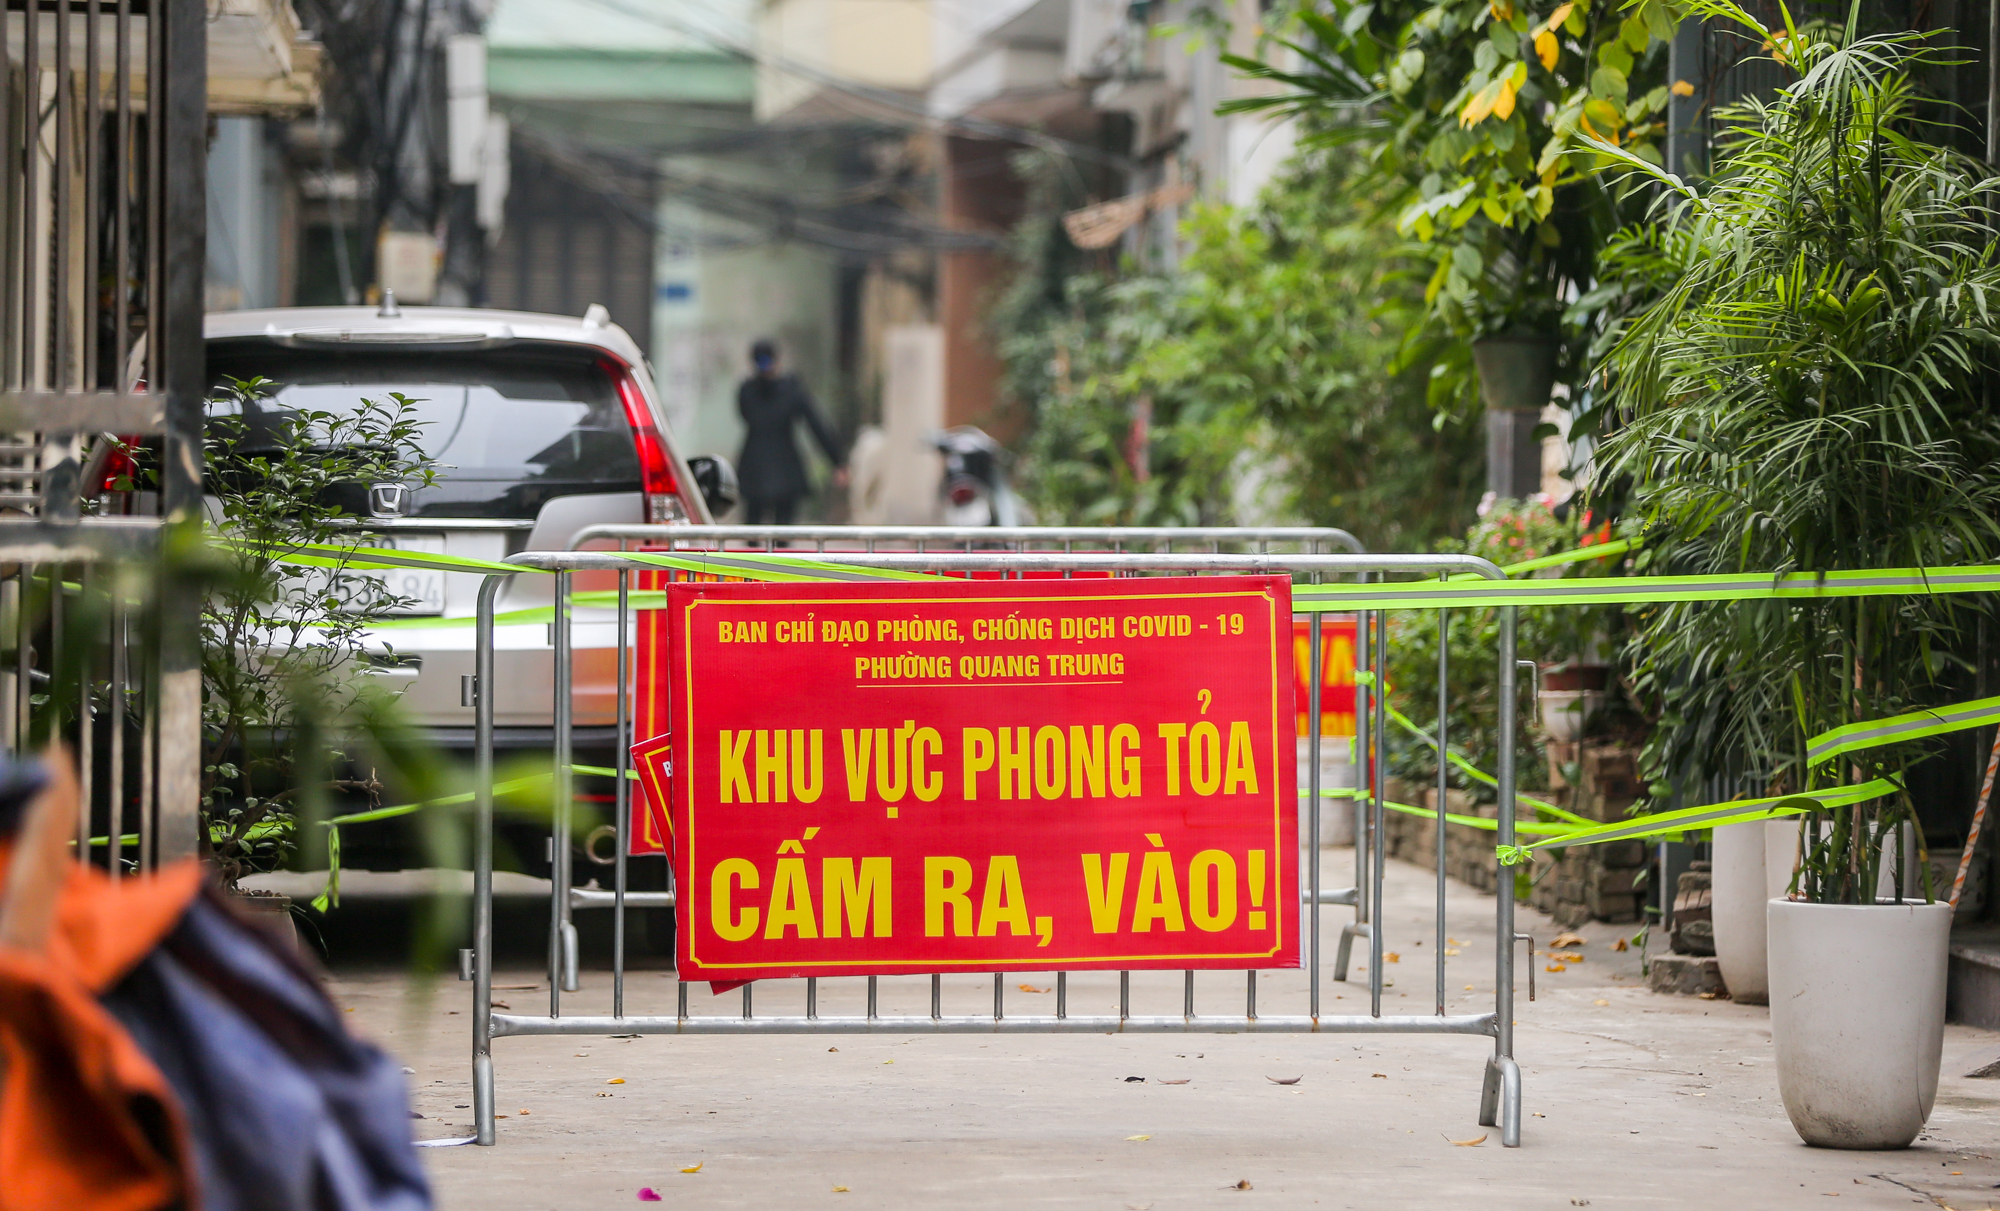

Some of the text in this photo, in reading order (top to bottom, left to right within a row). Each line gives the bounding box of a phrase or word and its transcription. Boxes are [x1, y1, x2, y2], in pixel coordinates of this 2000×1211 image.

[718, 620, 768, 643] BAN
[775, 612, 815, 643] CHỈ
[821, 620, 870, 647] ĐẠO
[877, 614, 965, 644] PHÒNG,
[972, 610, 1053, 641] CHỐNG
[1060, 616, 1116, 644] DỊCH
[1122, 614, 1192, 637] COVID
[1216, 613, 1245, 635] 19
[855, 651, 1125, 680] PHƯỜNG QUANG TRUNG
[719, 688, 1260, 819] KHU VỰC PHONG TỎA
[710, 826, 1268, 948] CẤM RA, VÀO!
